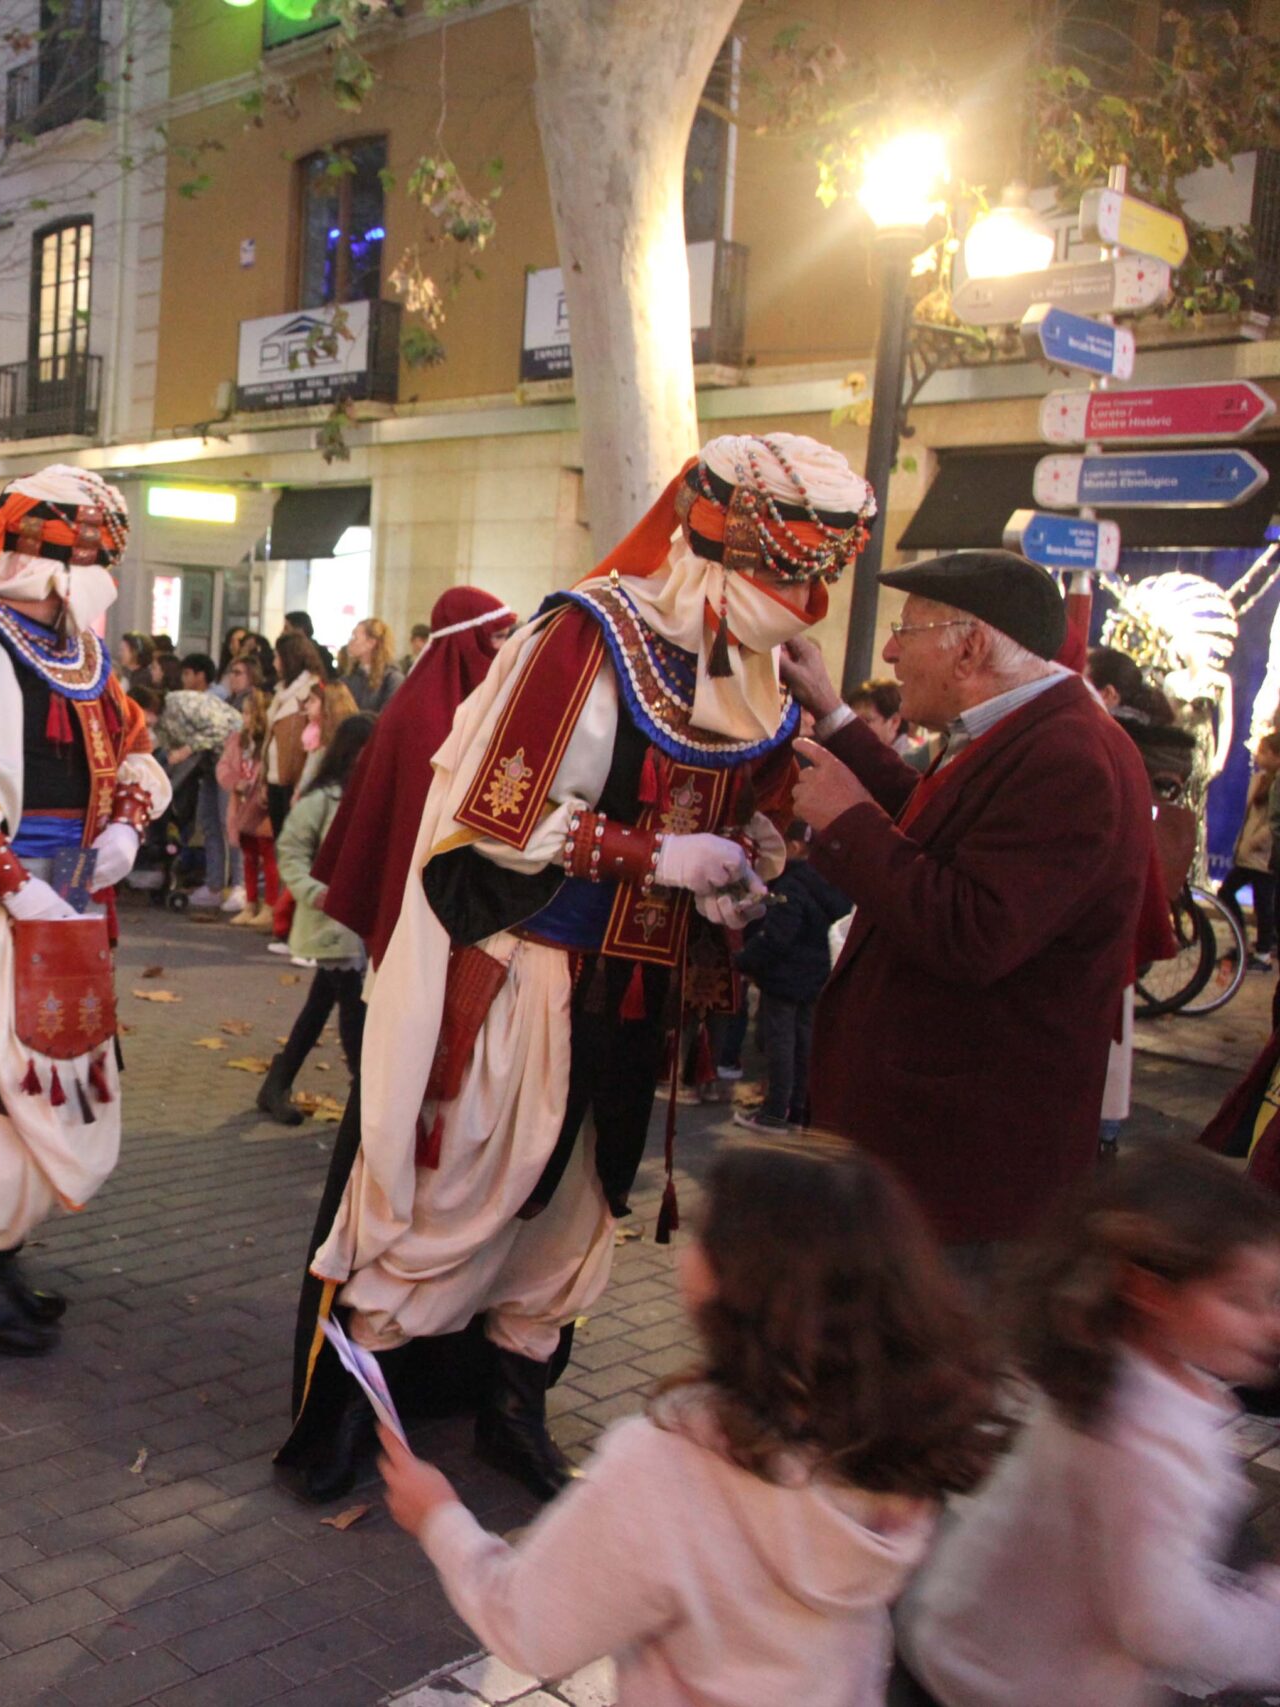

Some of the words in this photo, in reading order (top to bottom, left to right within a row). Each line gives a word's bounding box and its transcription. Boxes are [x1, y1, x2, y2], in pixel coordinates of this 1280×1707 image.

[1091, 408, 1126, 419] Loreto
[1083, 478, 1117, 490] Museo
[1119, 476, 1179, 491] Etnológico
